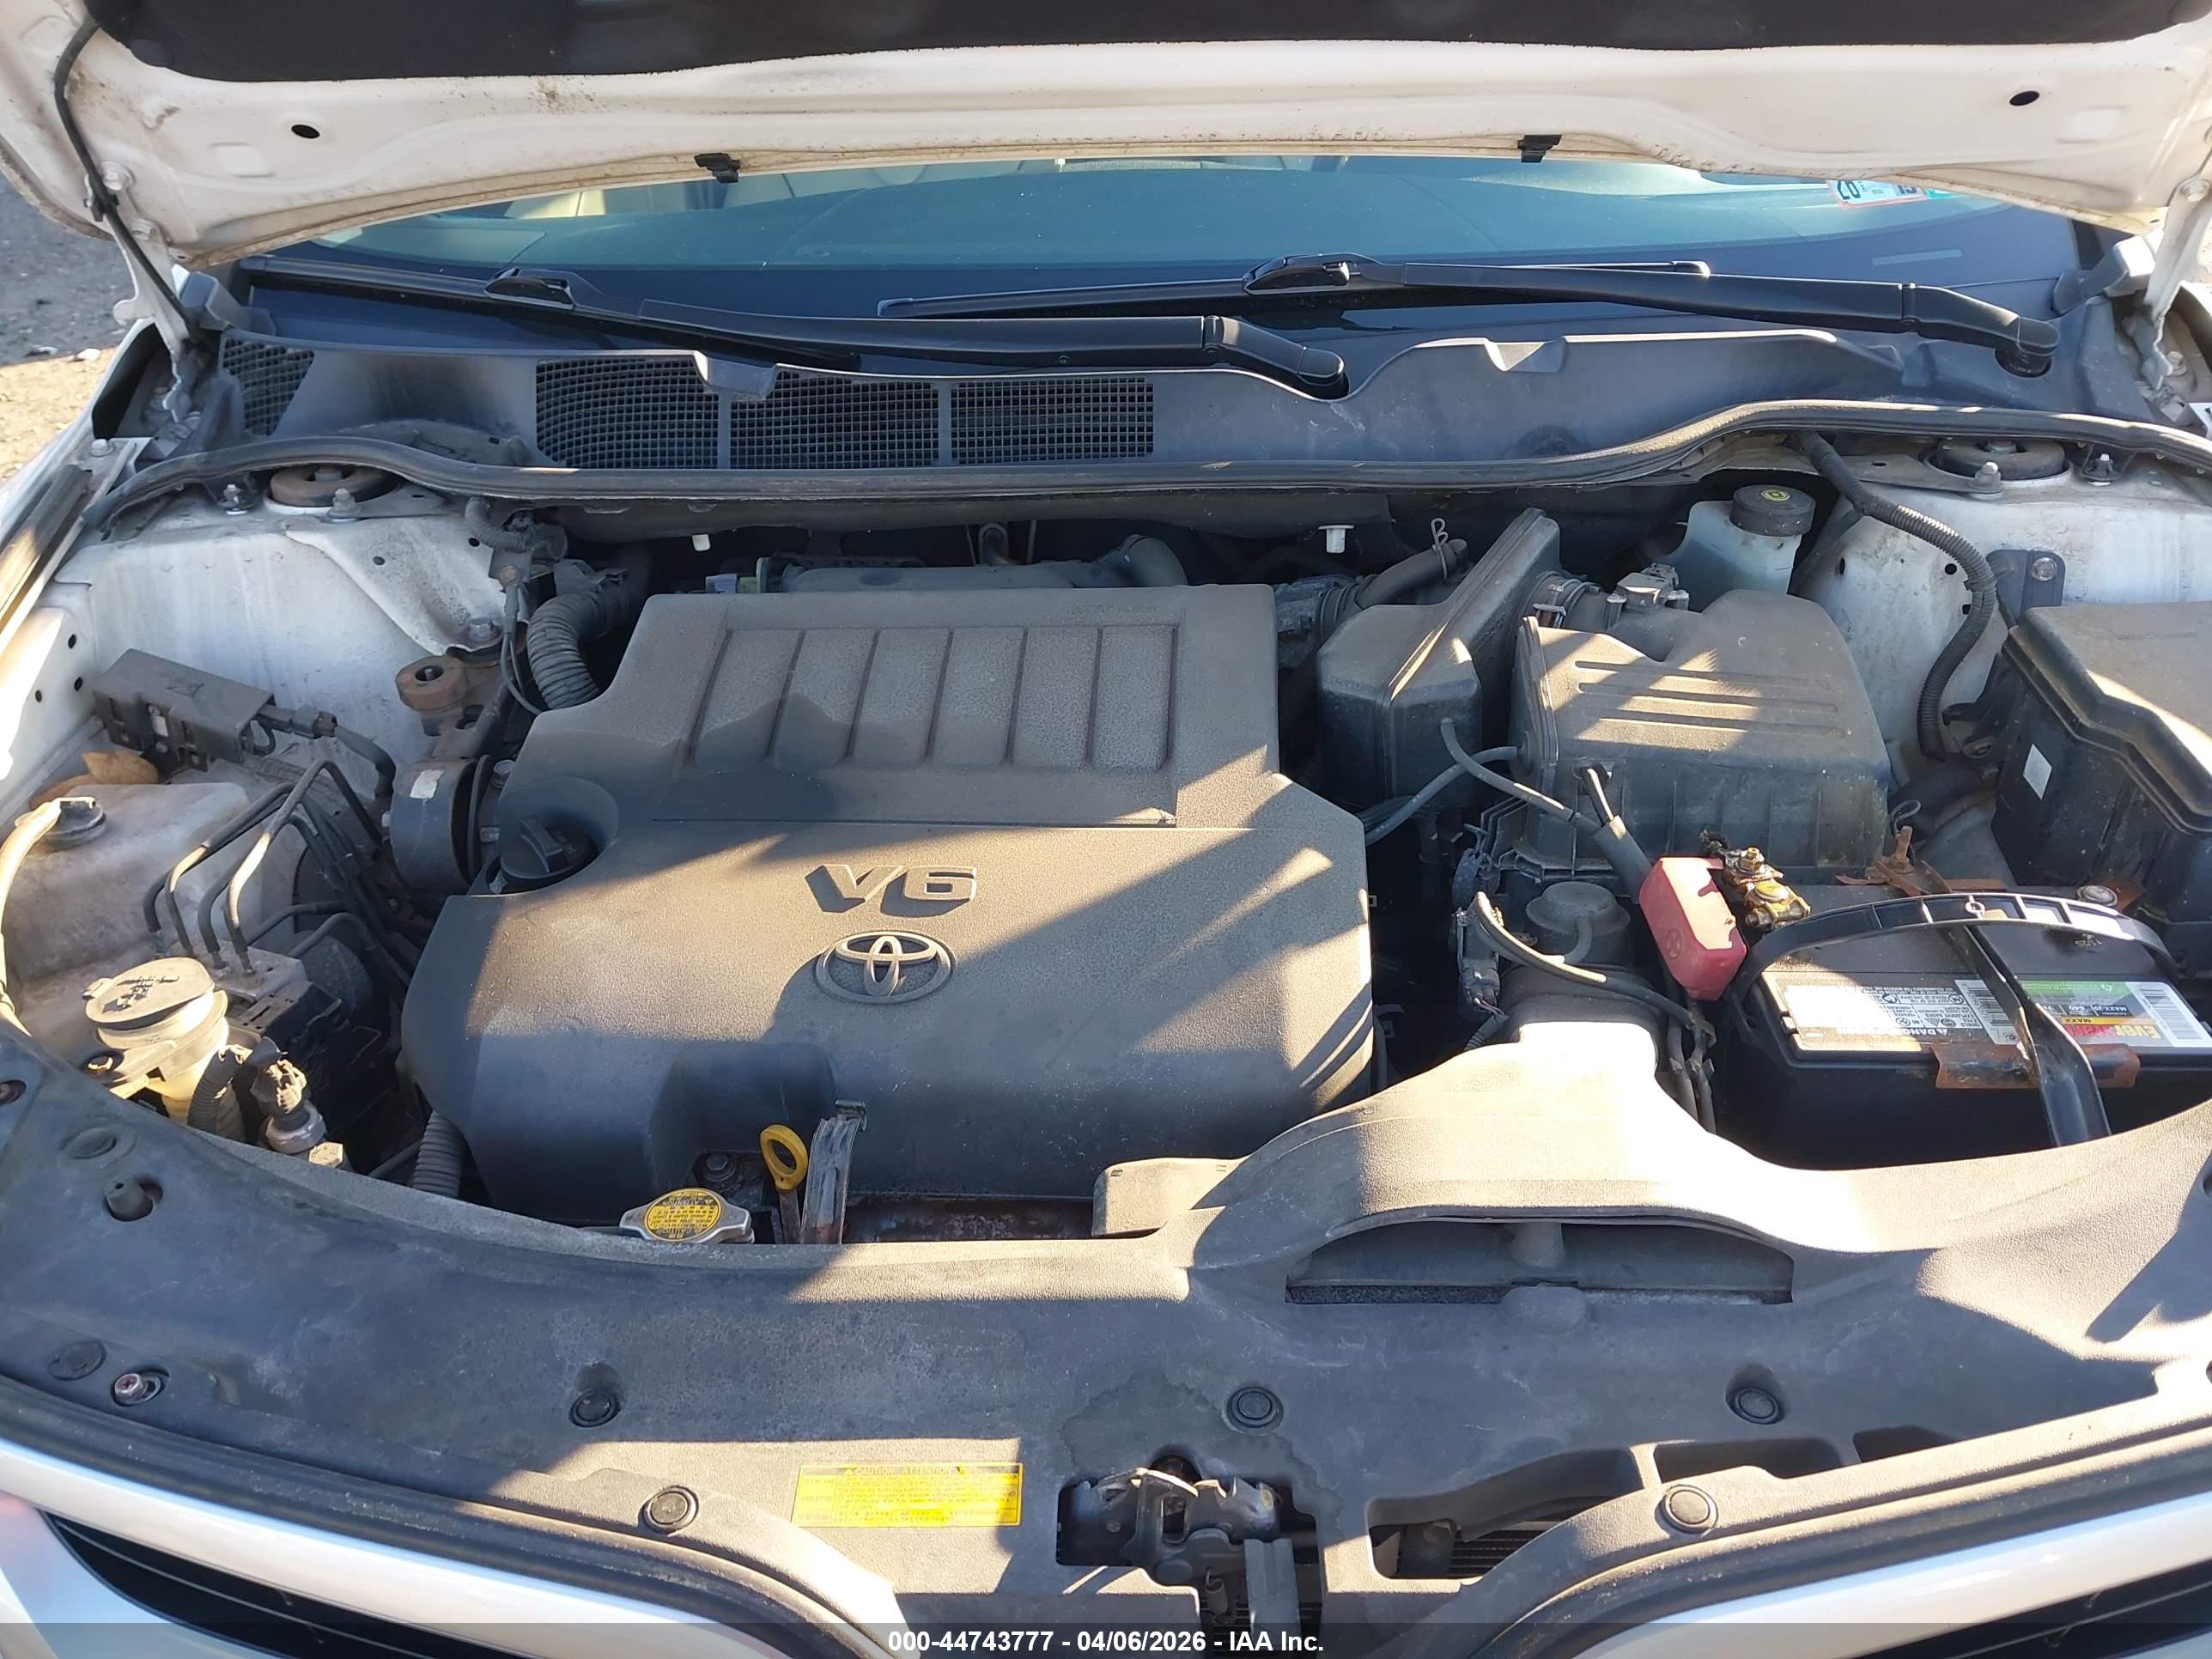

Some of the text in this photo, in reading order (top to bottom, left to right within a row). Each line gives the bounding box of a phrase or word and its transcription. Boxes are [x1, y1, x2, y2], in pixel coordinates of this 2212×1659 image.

[804, 864, 977, 918] V6
[855, 1467, 951, 1475] CAUTION ATTENTION
